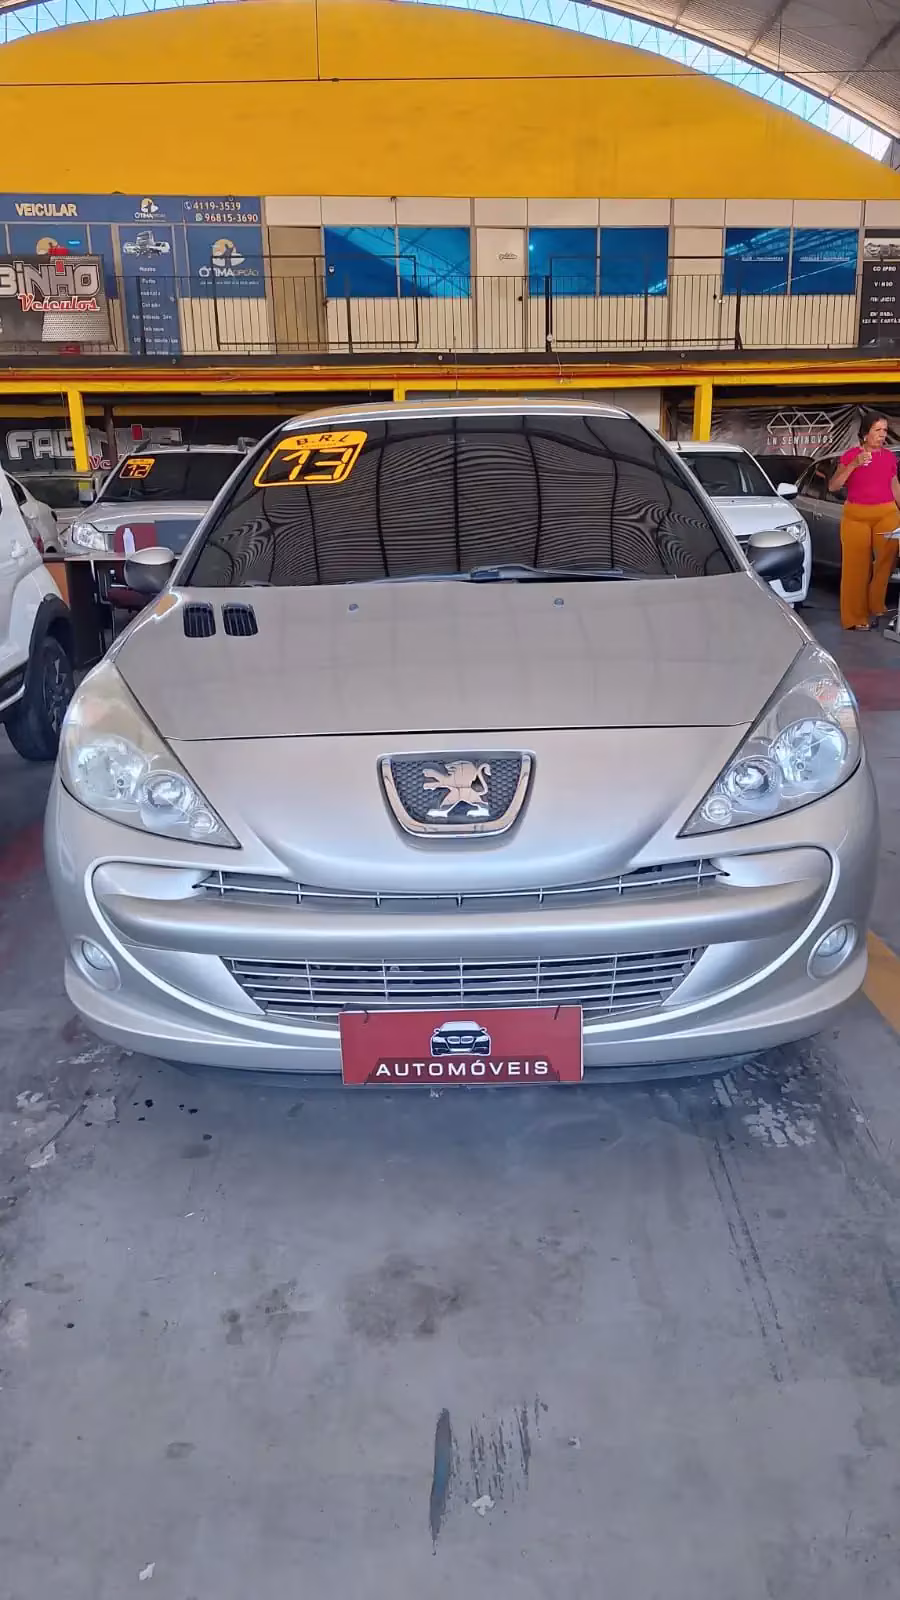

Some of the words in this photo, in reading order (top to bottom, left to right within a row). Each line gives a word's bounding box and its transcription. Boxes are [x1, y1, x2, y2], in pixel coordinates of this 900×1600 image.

[15, 203, 78, 217] VEICULAR
[193, 201, 241, 211] 4119-3539
[204, 213, 259, 223] 96815-3690
[782, 434, 834, 446] SEMINOVOS
[127, 464, 150, 477] 12
[281, 447, 354, 481] 13
[375, 1059, 549, 1077] AUTOMÓVEIS
